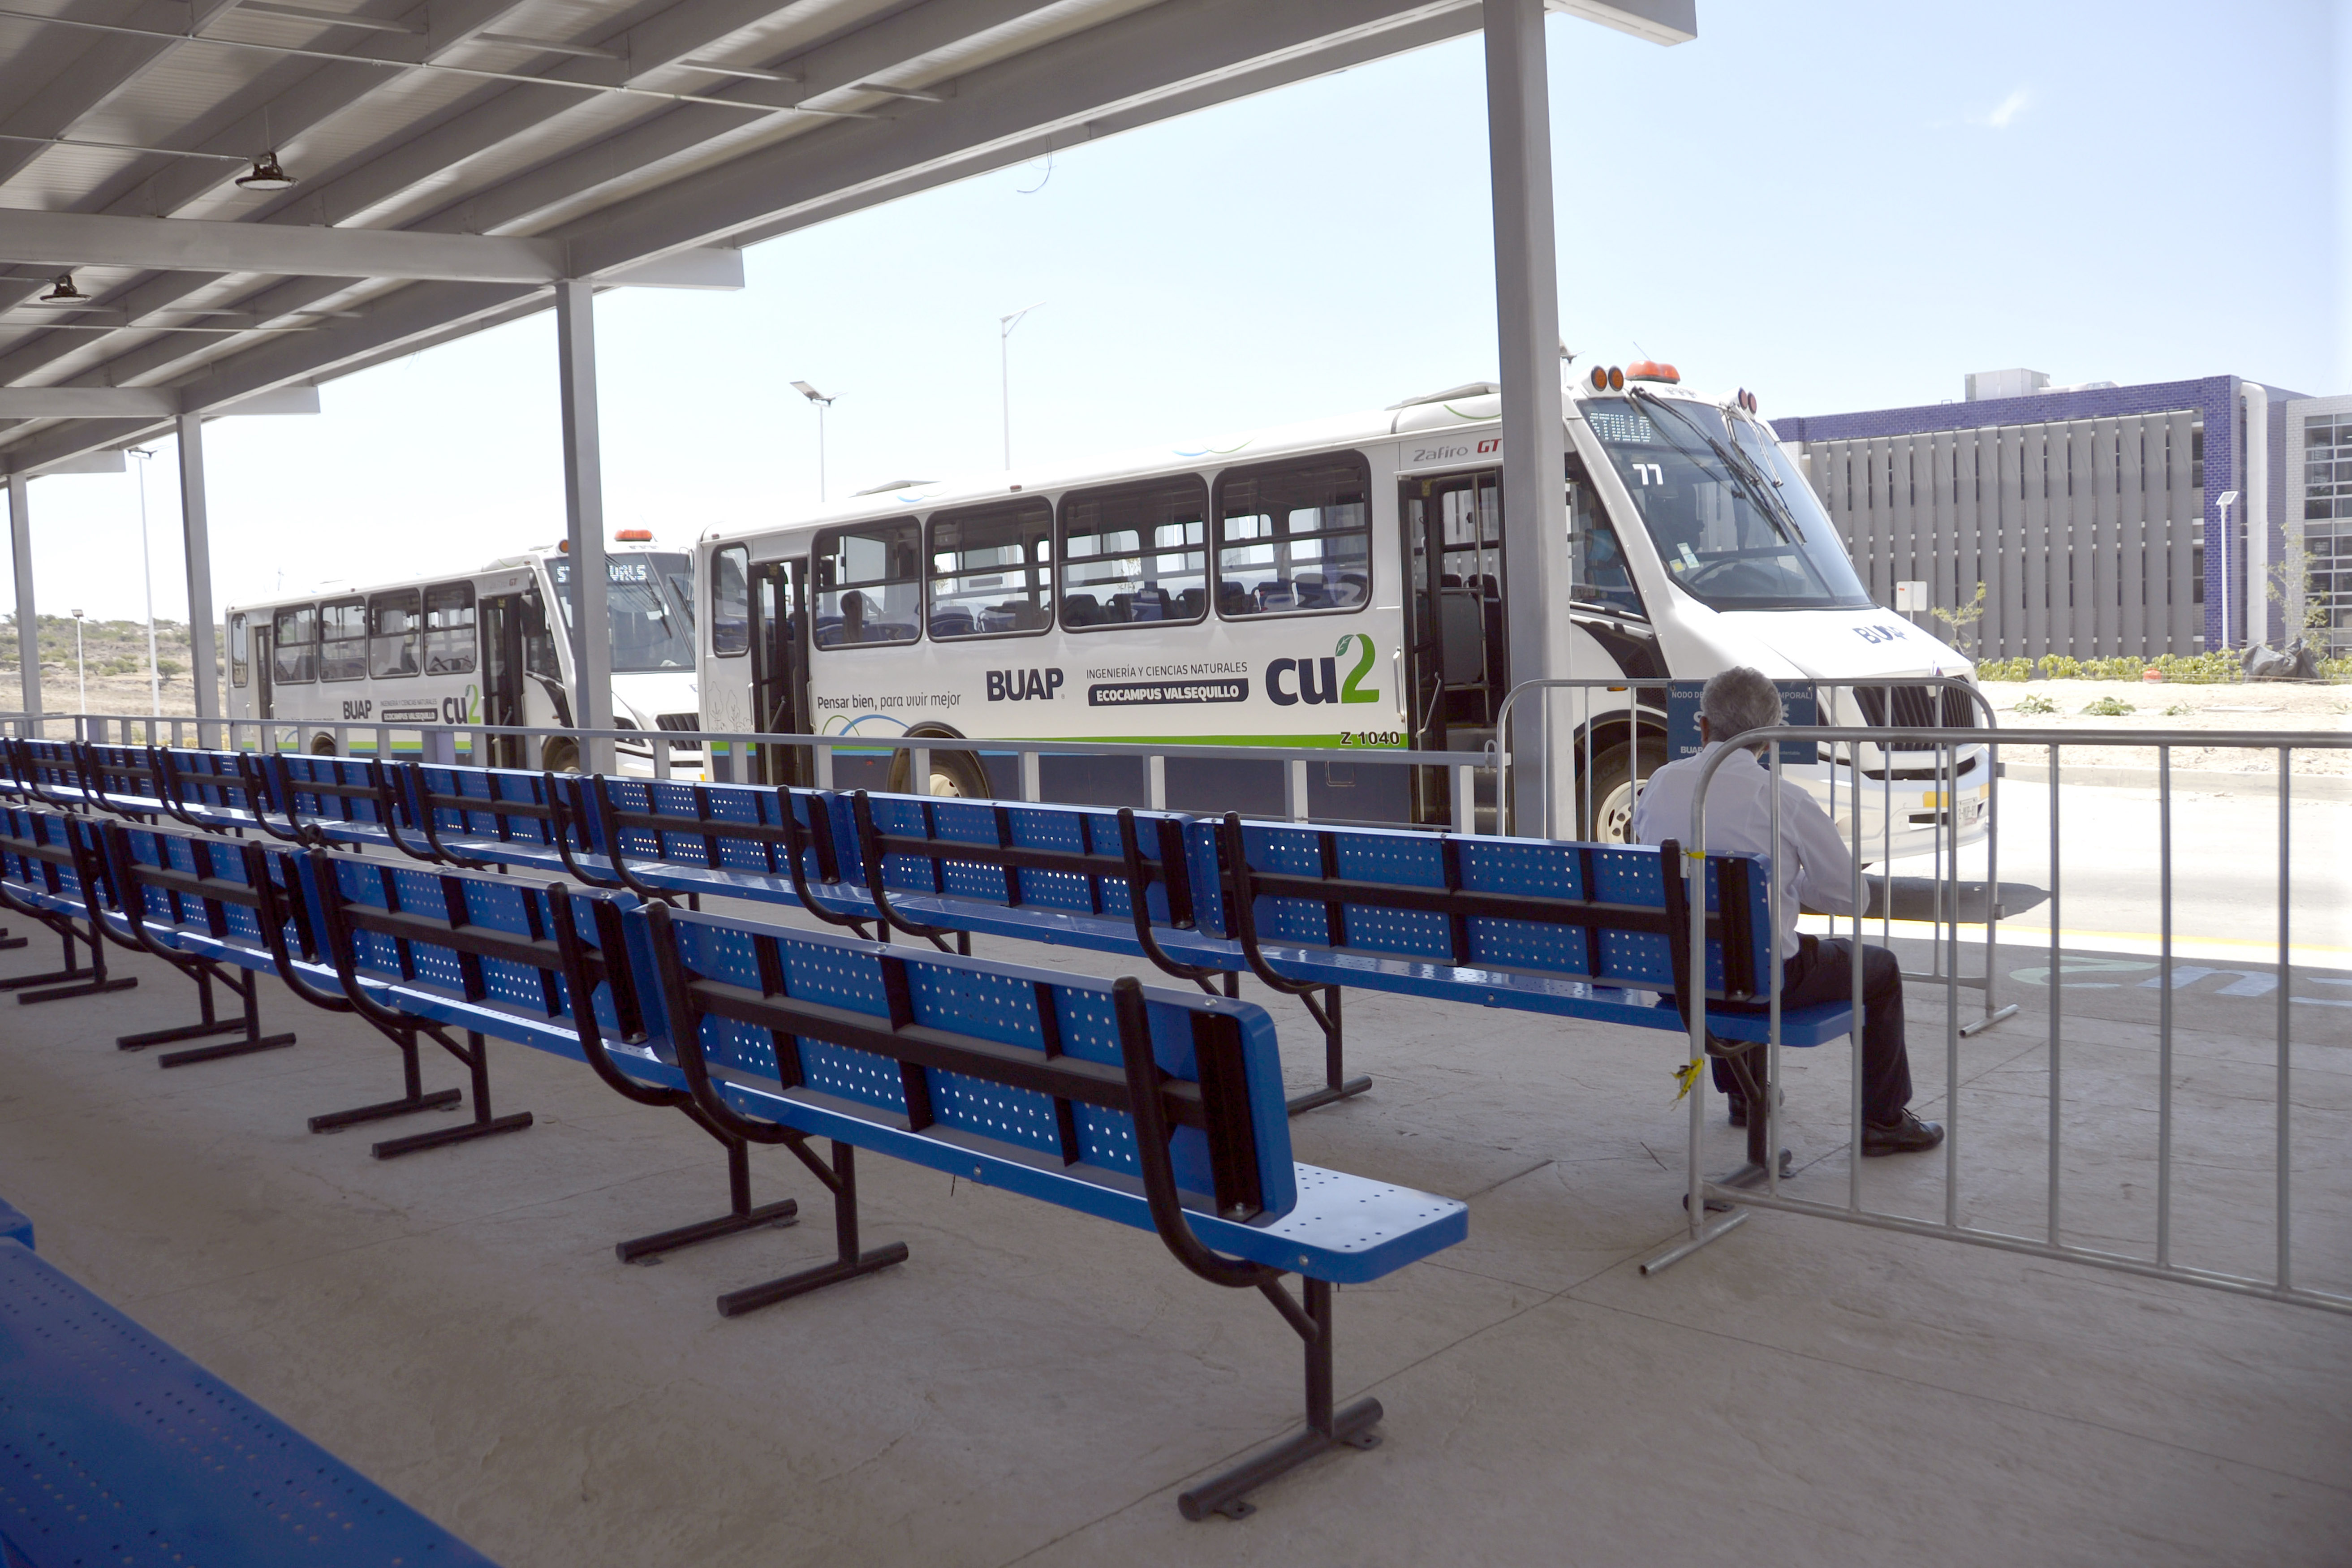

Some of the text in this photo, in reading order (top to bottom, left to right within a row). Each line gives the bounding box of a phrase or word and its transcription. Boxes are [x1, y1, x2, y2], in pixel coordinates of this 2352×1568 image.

[1413, 439, 1502, 461] Zafiro GT
[1632, 463, 1663, 485] 77
[1852, 625, 1909, 644] BUAP
[1086, 662, 1248, 679] INGENIERÍA Y CIENCIAS NATURALES
[1266, 633, 1379, 706] cu2
[986, 668, 1064, 702] BUAP
[1096, 685, 1239, 702] ECOCAMPUS VALSEQUILLO
[442, 684, 481, 724] cu2
[817, 691, 961, 711] Pensar bien, para vivir mejor
[1779, 691, 1813, 700] MPORAL)
[343, 699, 372, 719] BUAP
[1341, 731, 1400, 745] Z 1040
